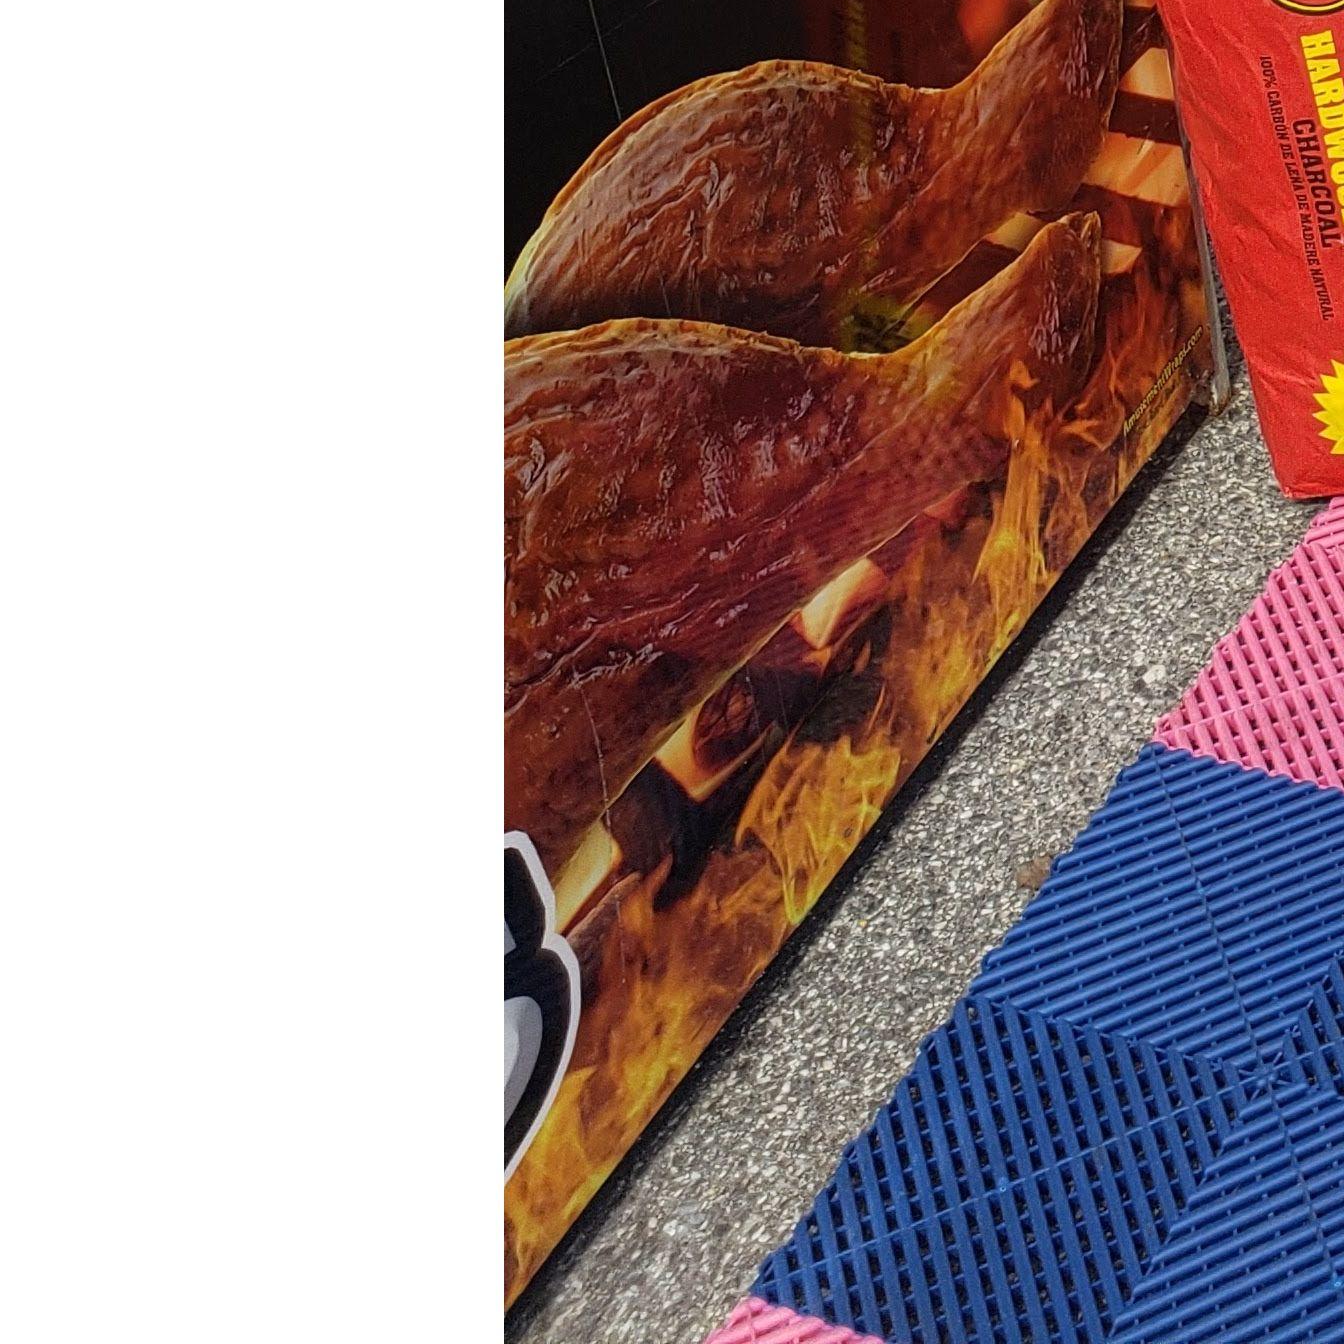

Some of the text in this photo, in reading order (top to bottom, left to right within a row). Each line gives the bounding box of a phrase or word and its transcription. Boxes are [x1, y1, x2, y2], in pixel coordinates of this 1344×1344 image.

[1259, 55, 1278, 89] 100%
[1280, 143, 1295, 161] DE
[1292, 118, 1343, 249] CHARCOAL
[1295, 193, 1310, 212] DE
[1300, 212, 1321, 267] MADERE
[1310, 267, 1335, 322] NATURAL
